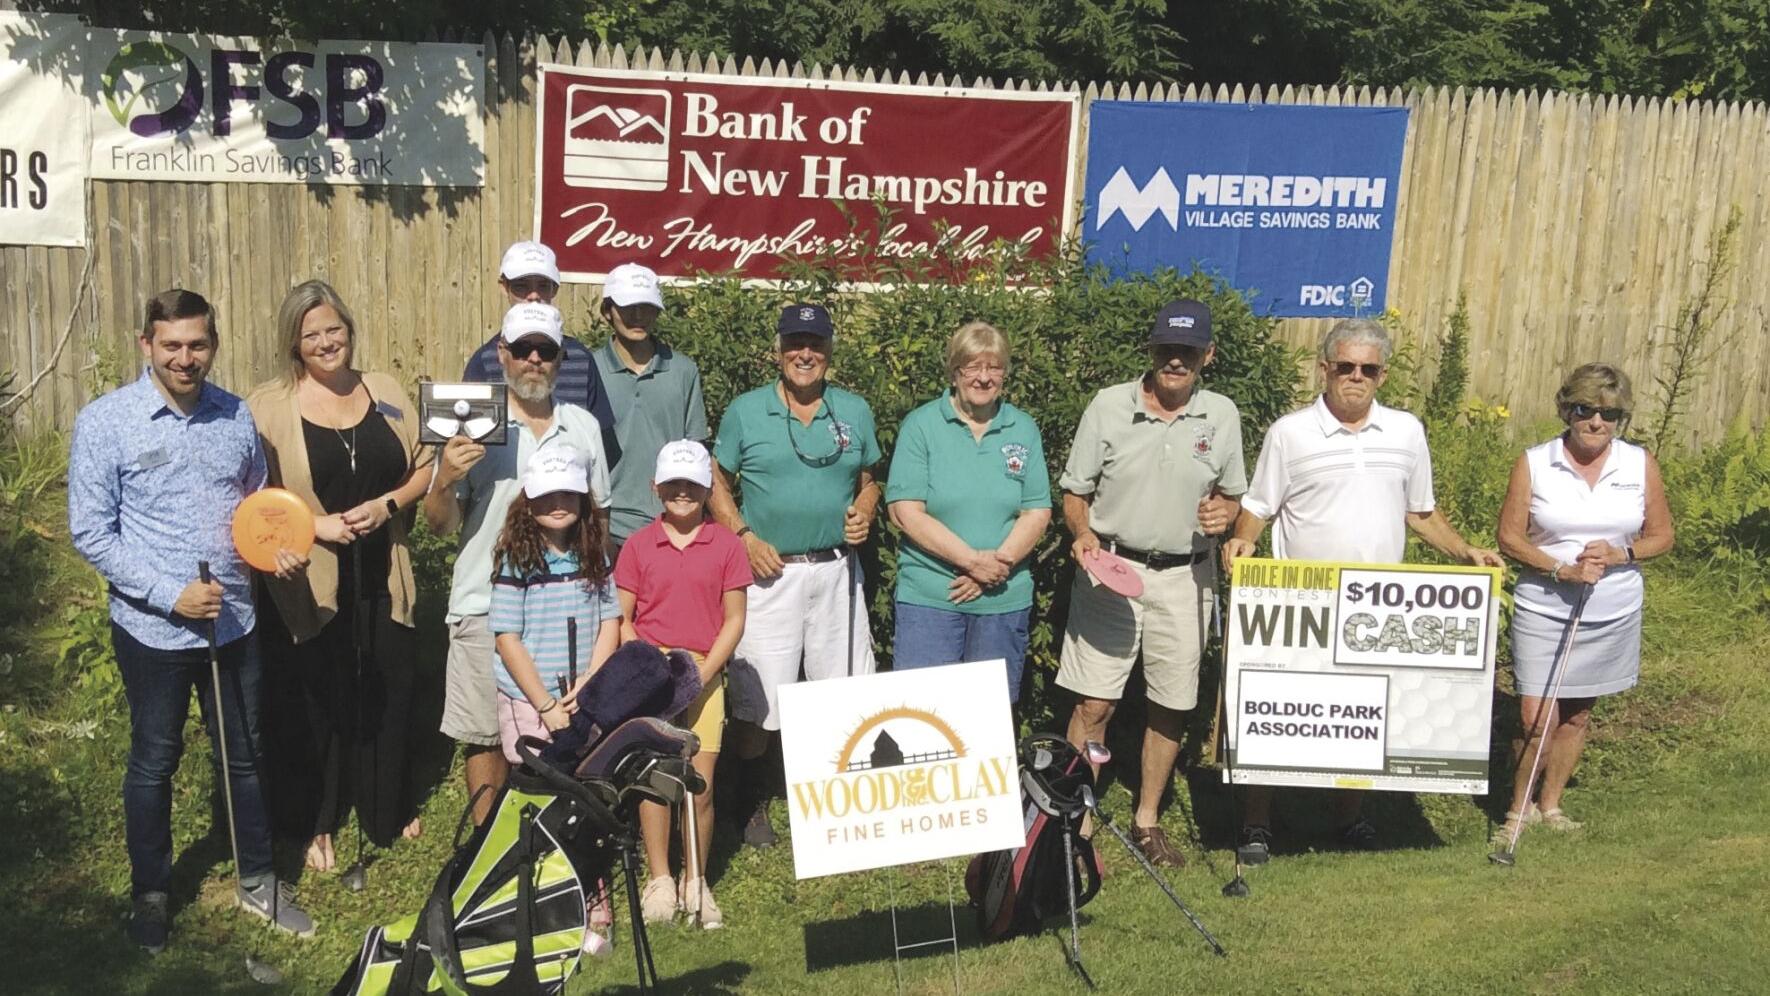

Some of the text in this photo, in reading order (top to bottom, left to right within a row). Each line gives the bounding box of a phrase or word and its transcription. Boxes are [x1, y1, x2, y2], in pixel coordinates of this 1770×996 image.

[211, 49, 387, 140] FSB
[682, 92, 872, 145] Bank of
[112, 145, 394, 182] Franklin Savings Bank
[679, 150, 1048, 215] New Hampshire
[1186, 174, 1387, 208] MEREDITH
[560, 202, 656, 249] New
[1185, 211, 1381, 230] VILLAGE SAVINGS BANK
[1300, 285, 1345, 307] FDIC
[1238, 588, 1333, 601] CONTEST
[1239, 564, 1335, 591] HOLE IN ONE
[1346, 581, 1484, 613] $10,000
[1238, 603, 1331, 649] WIN
[1342, 612, 1481, 656] CASH
[1244, 700, 1384, 721] BOLDUC PARK
[1246, 721, 1379, 741] ASSOCIATION
[792, 771, 901, 822] WOOD
[927, 755, 1013, 804] CLAY
[827, 808, 989, 845] FINE HOMES
